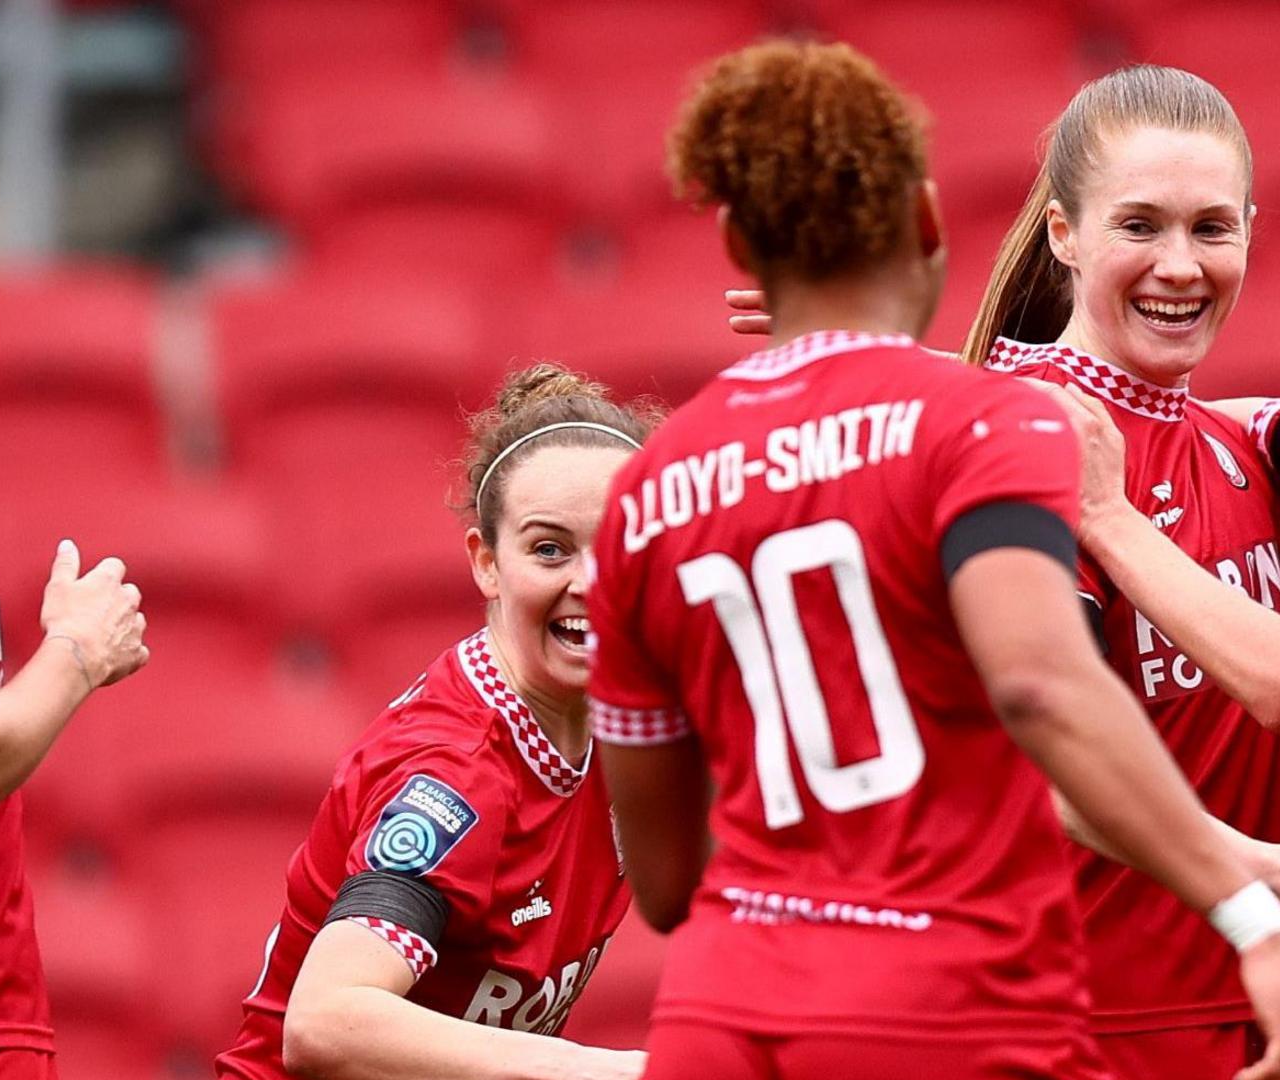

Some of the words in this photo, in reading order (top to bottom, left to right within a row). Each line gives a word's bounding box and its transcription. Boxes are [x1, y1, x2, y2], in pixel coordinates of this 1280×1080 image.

[619, 398, 926, 555] LLOYD-SMITH
[675, 517, 926, 832] 10
[425, 784, 470, 823] BARCLAYS
